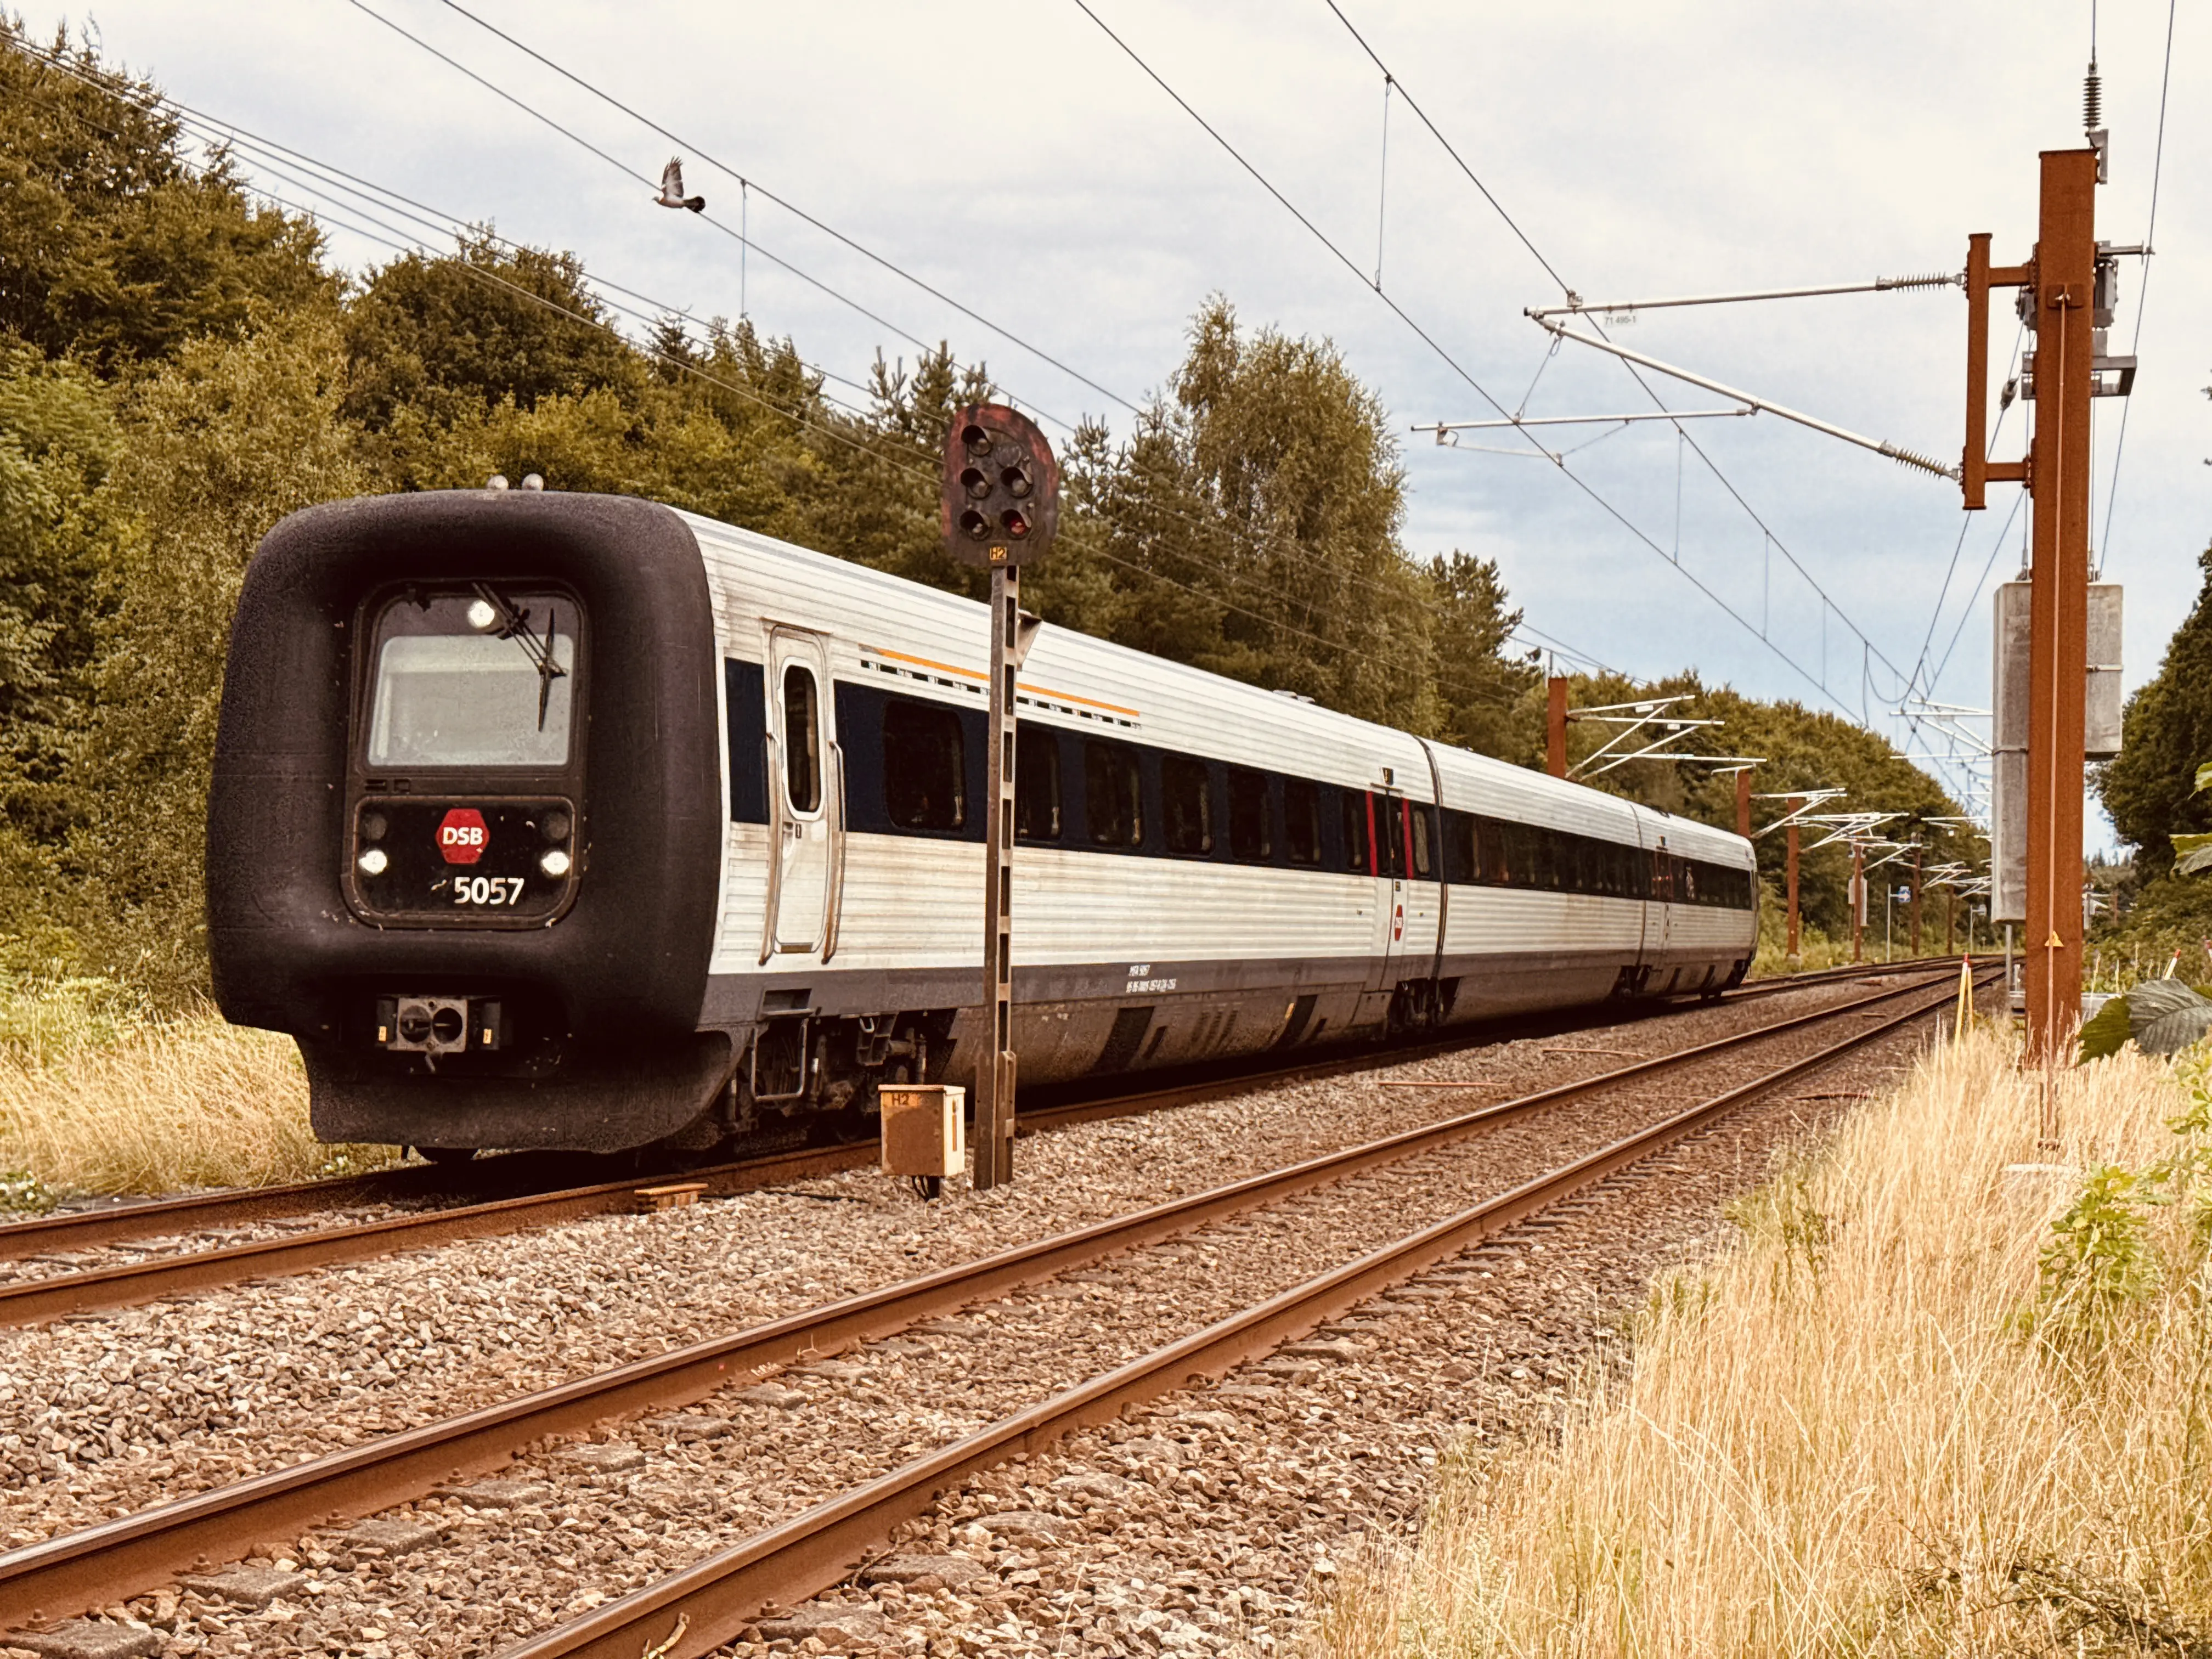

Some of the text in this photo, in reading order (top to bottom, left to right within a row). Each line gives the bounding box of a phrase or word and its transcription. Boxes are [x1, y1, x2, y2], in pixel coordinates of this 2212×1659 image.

[991, 547, 1006, 558] H2
[443, 827, 483, 845] DSB
[454, 877, 524, 905] 5057
[891, 1092, 909, 1106] H2
